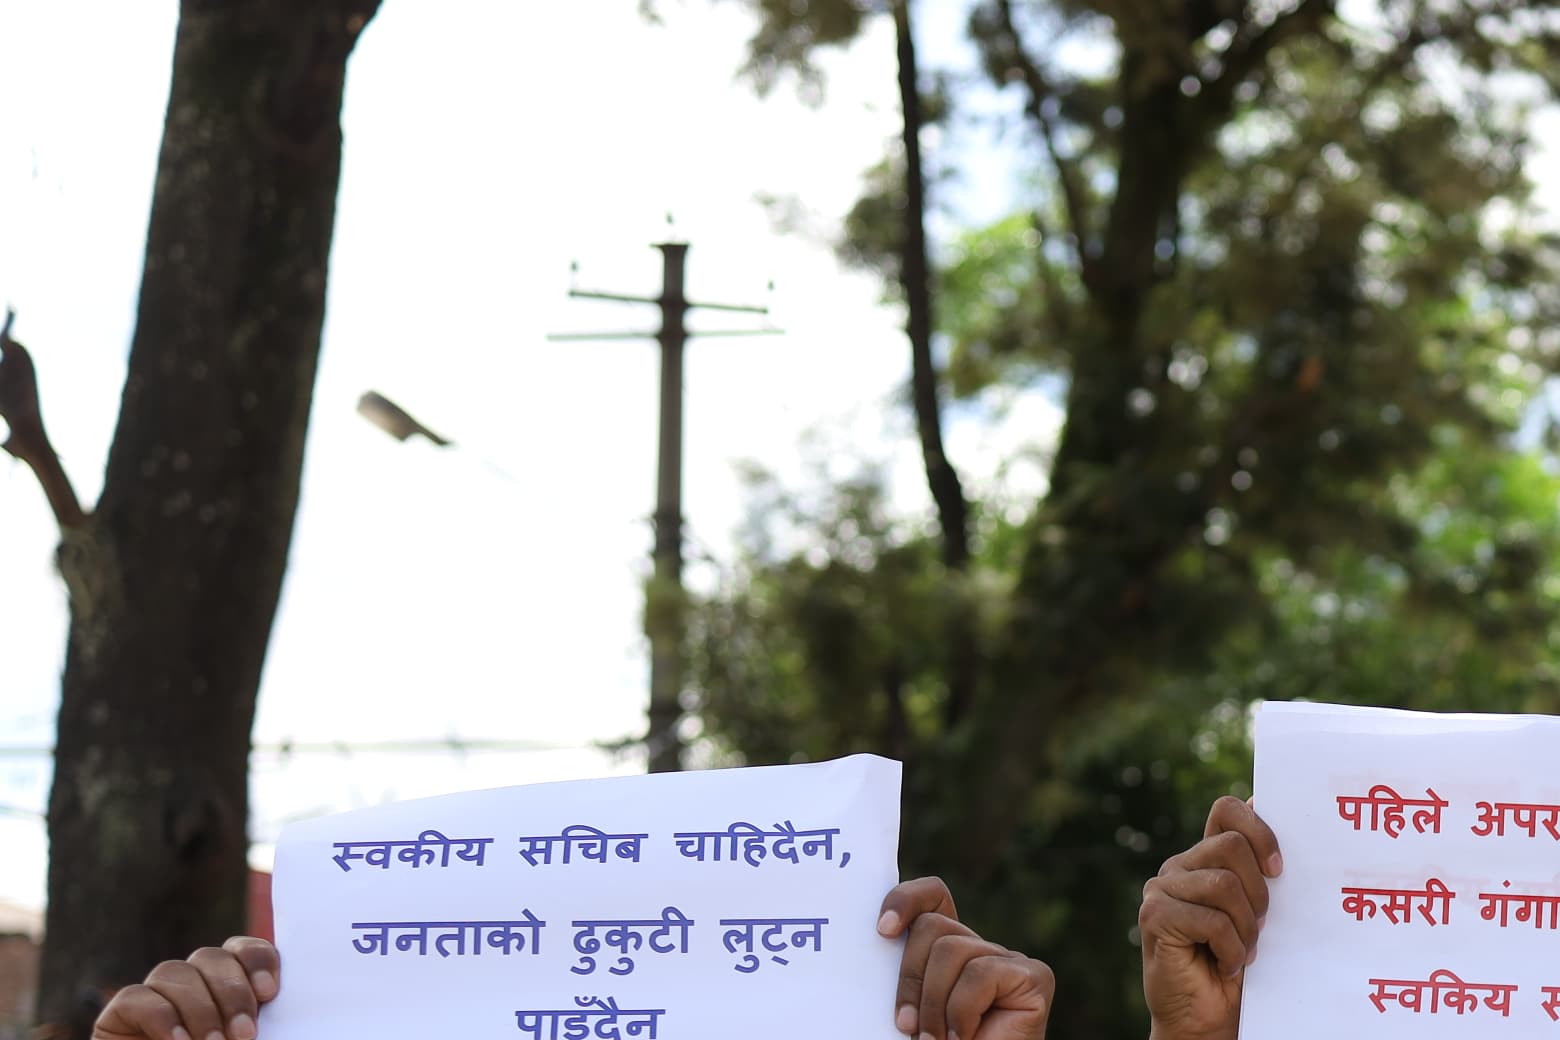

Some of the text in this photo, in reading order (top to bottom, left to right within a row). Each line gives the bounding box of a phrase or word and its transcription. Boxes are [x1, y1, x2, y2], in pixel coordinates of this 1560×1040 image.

[1335, 784, 1450, 840] पहिले
[331, 819, 851, 873] स्वकीय सचिब चाहिदैन,
[1340, 877, 1457, 927] कसरी
[351, 906, 830, 976] जनताको ढुकुटी लुट्न
[1368, 968, 1519, 1017] स्वकिय
